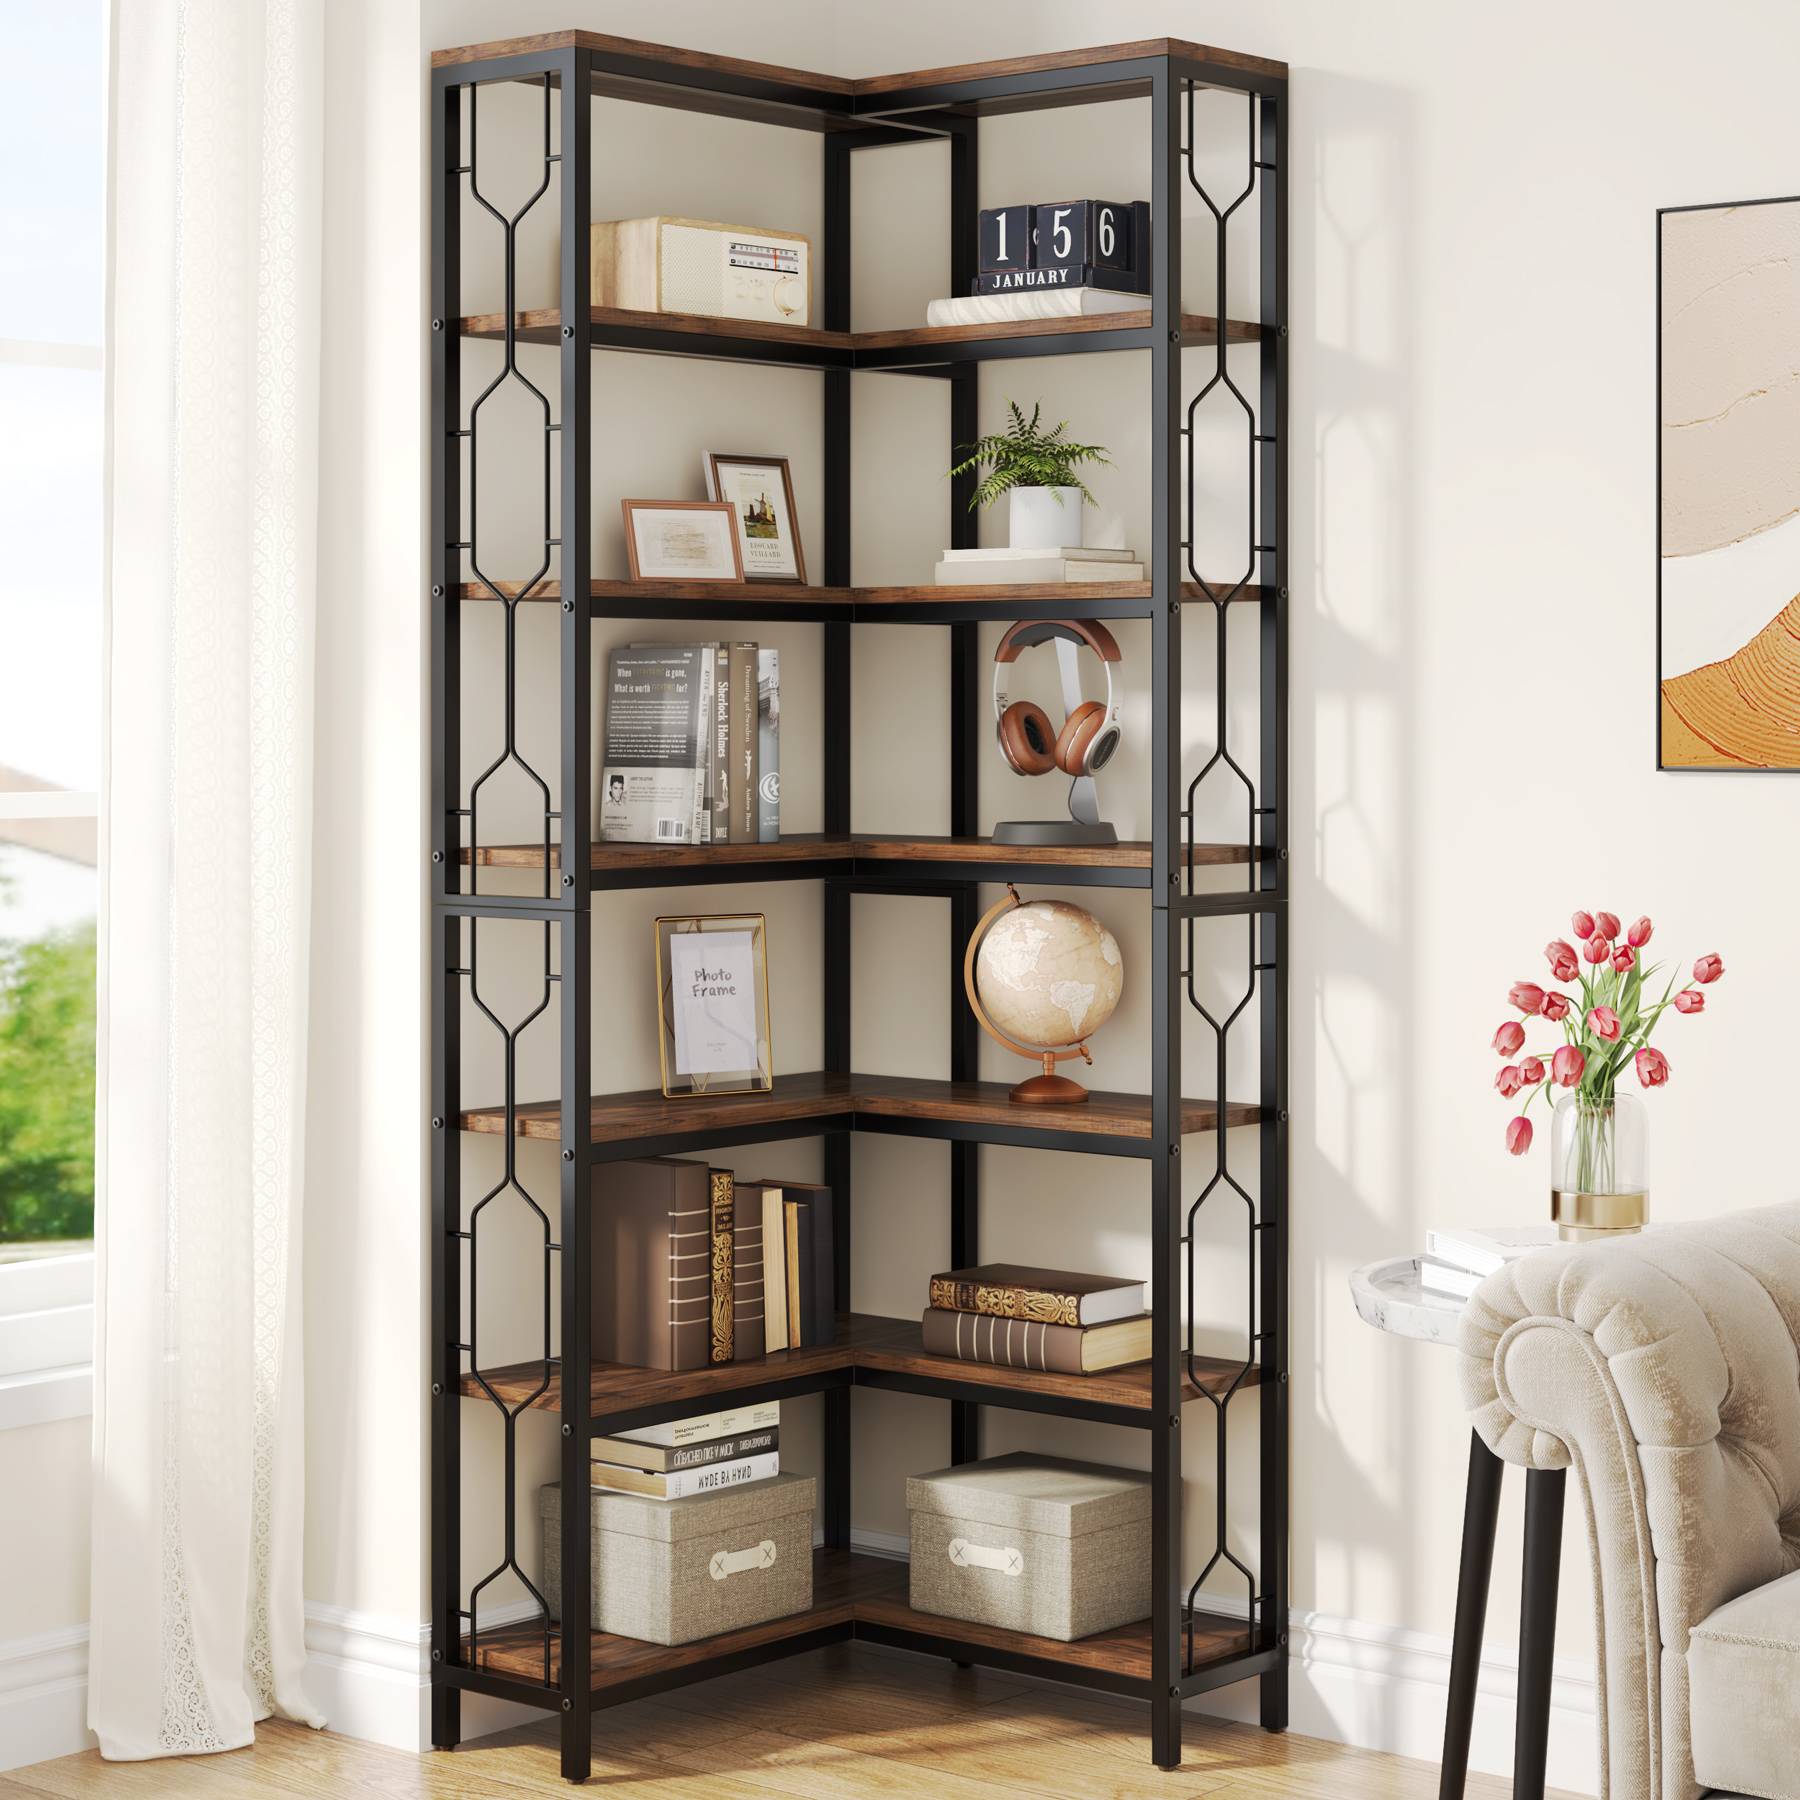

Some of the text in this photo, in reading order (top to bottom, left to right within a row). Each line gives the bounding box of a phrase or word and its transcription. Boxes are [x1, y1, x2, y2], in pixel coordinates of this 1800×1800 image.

[995, 207, 1115, 262] 1 5 6
[992, 268, 1069, 289] JANUARY
[617, 668, 632, 677] When
[665, 669, 671, 677] is
[614, 683, 628, 693] What
[628, 684, 634, 693] is
[634, 683, 651, 693] worth
[676, 683, 688, 693] for?
[717, 681, 729, 758] Sherlock Holmes
[694, 968, 732, 983] Photo
[692, 983, 737, 998] Frame
